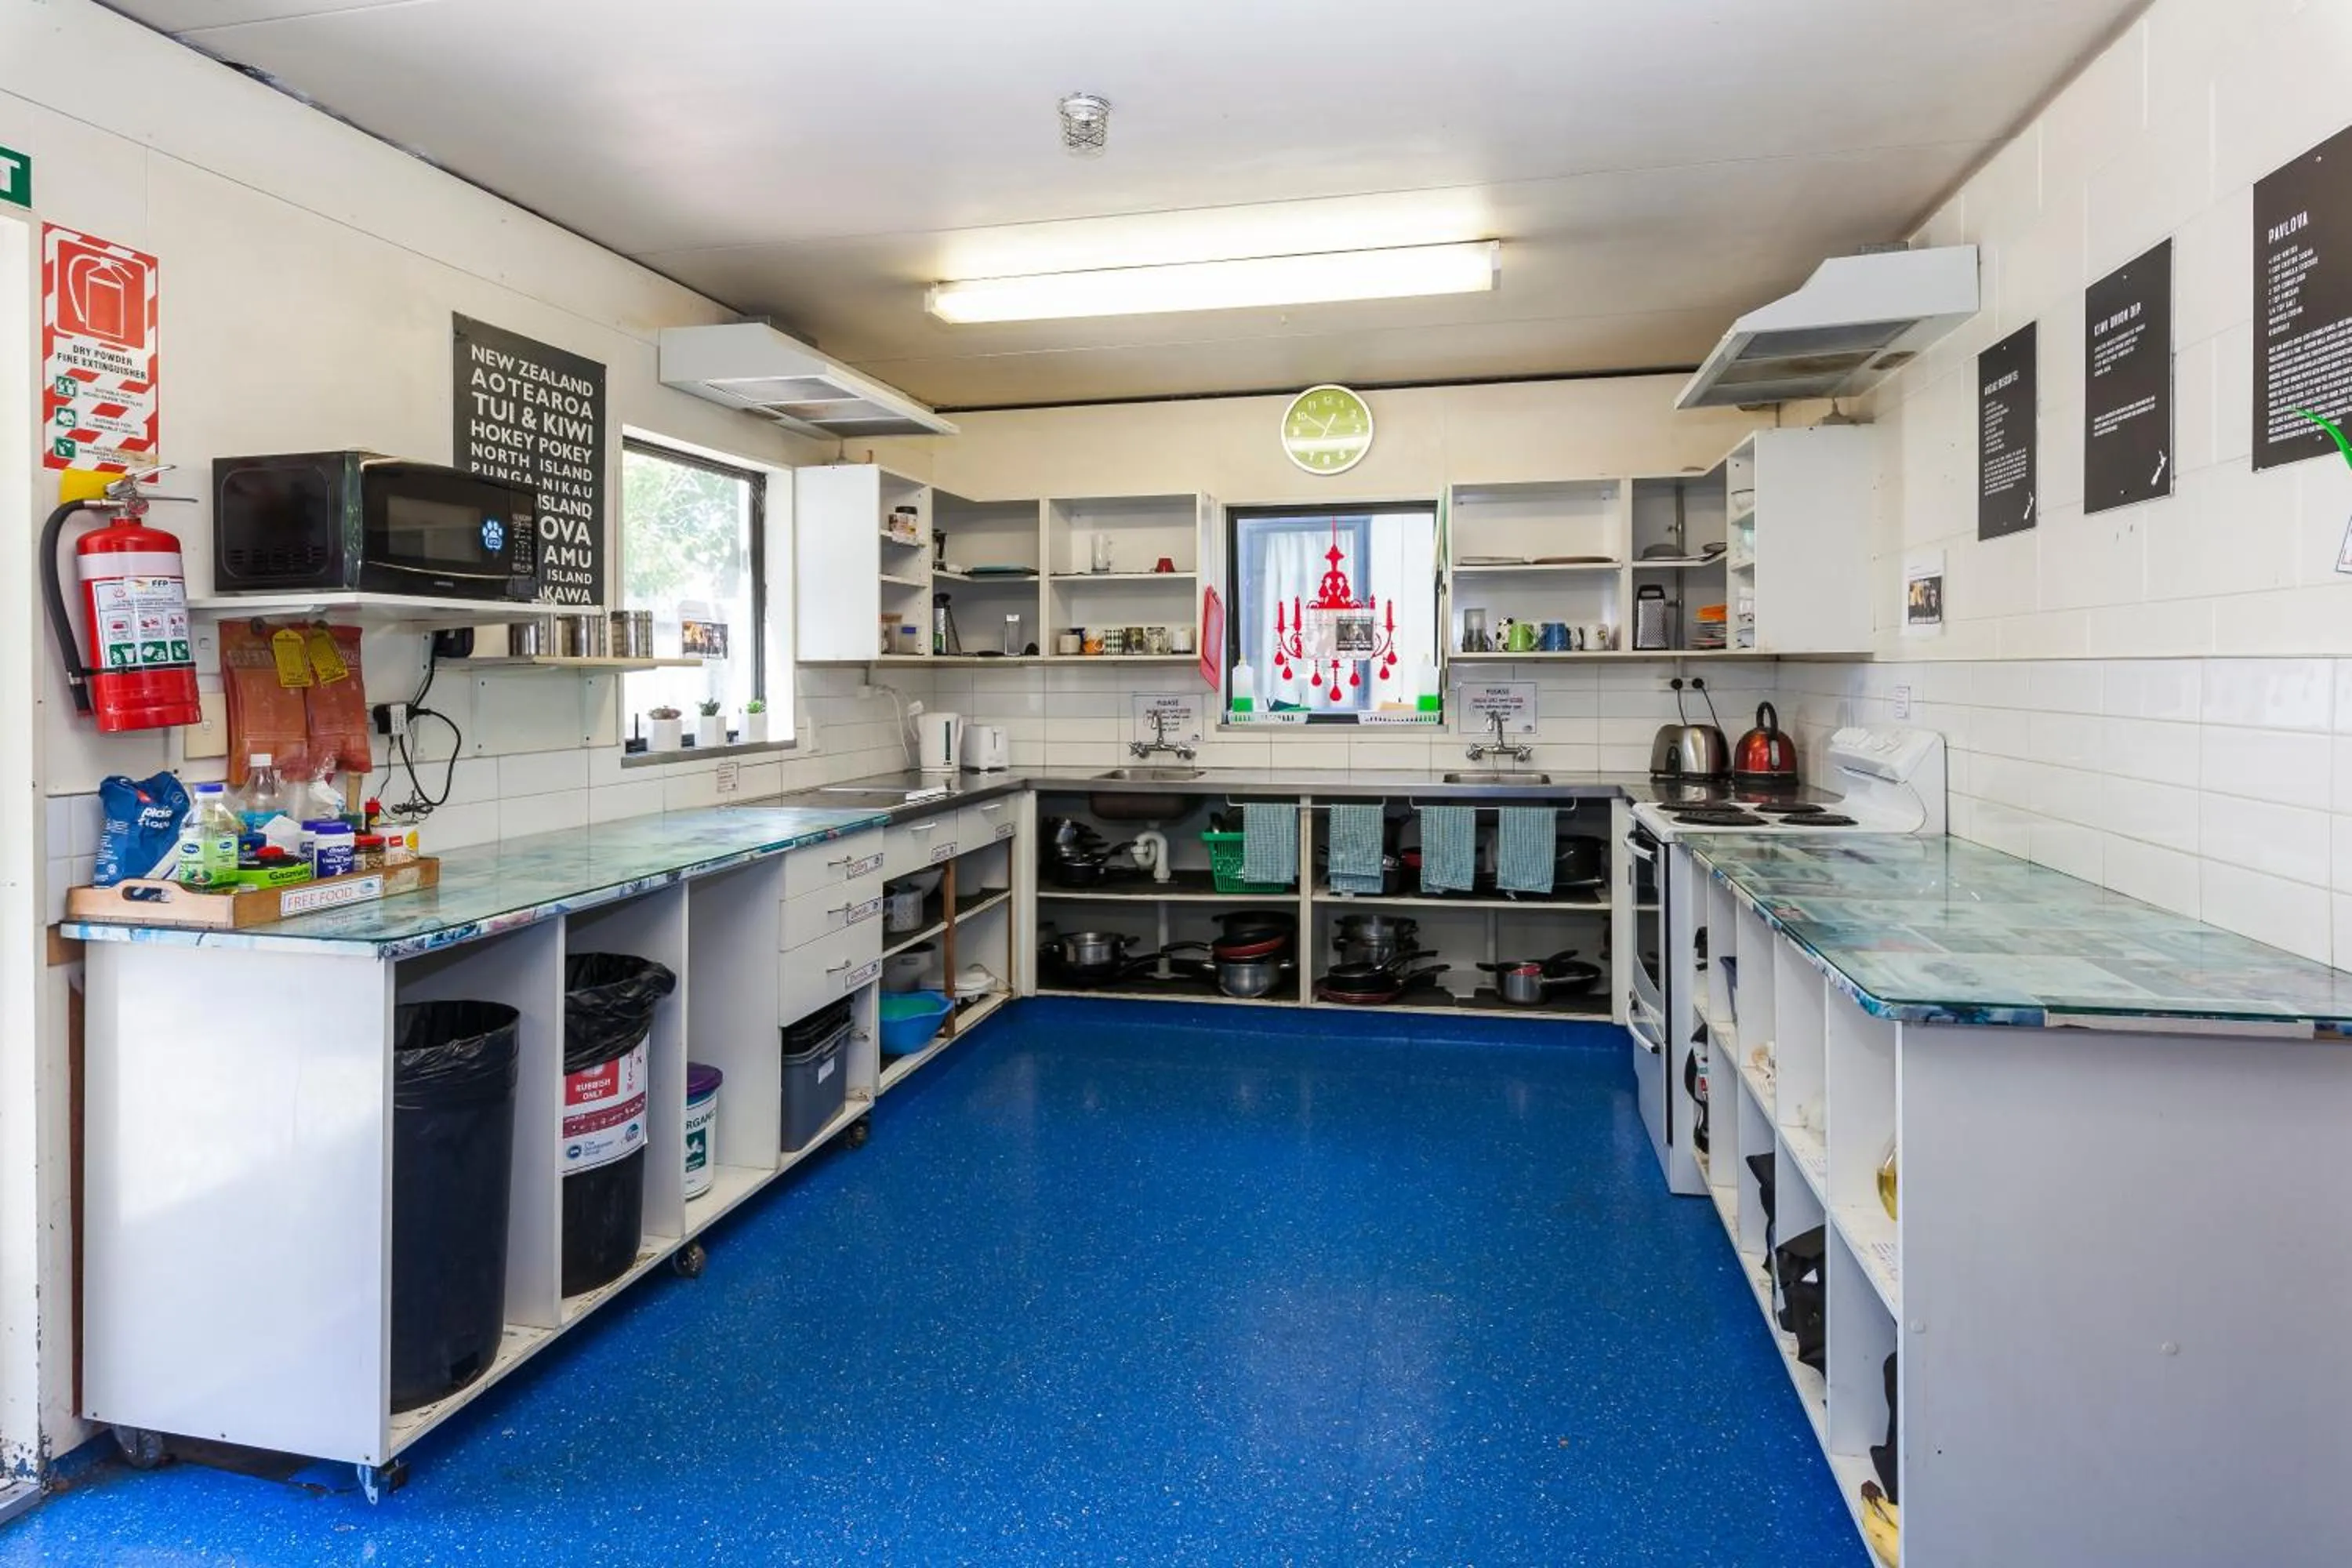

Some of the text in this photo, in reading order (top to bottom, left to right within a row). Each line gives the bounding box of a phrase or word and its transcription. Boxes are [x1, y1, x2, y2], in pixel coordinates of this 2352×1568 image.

[2268, 210, 2309, 244] PAVLOVA
[56, 353, 147, 379] FIRE EXTINGUISHER
[73, 344, 132, 366] DRY POWDER
[471, 344, 593, 397] NEW ZEALAND
[471, 367, 593, 420] AOTEAROA
[471, 391, 593, 445] TUI & KIWI
[471, 419, 592, 464] HOKEY POKEY
[471, 441, 592, 482] NORTH ISLAND
[543, 477, 592, 499] NIKAU
[538, 493, 592, 521] ISLAND
[540, 516, 592, 546] OVA
[544, 545, 592, 568] AMU
[547, 568, 592, 584] ISLAND
[539, 585, 592, 604] KAWA
[288, 887, 352, 909] FREE FOOD
[575, 1078, 611, 1092] RUBBISH
[583, 1090, 603, 1100] ONLY
